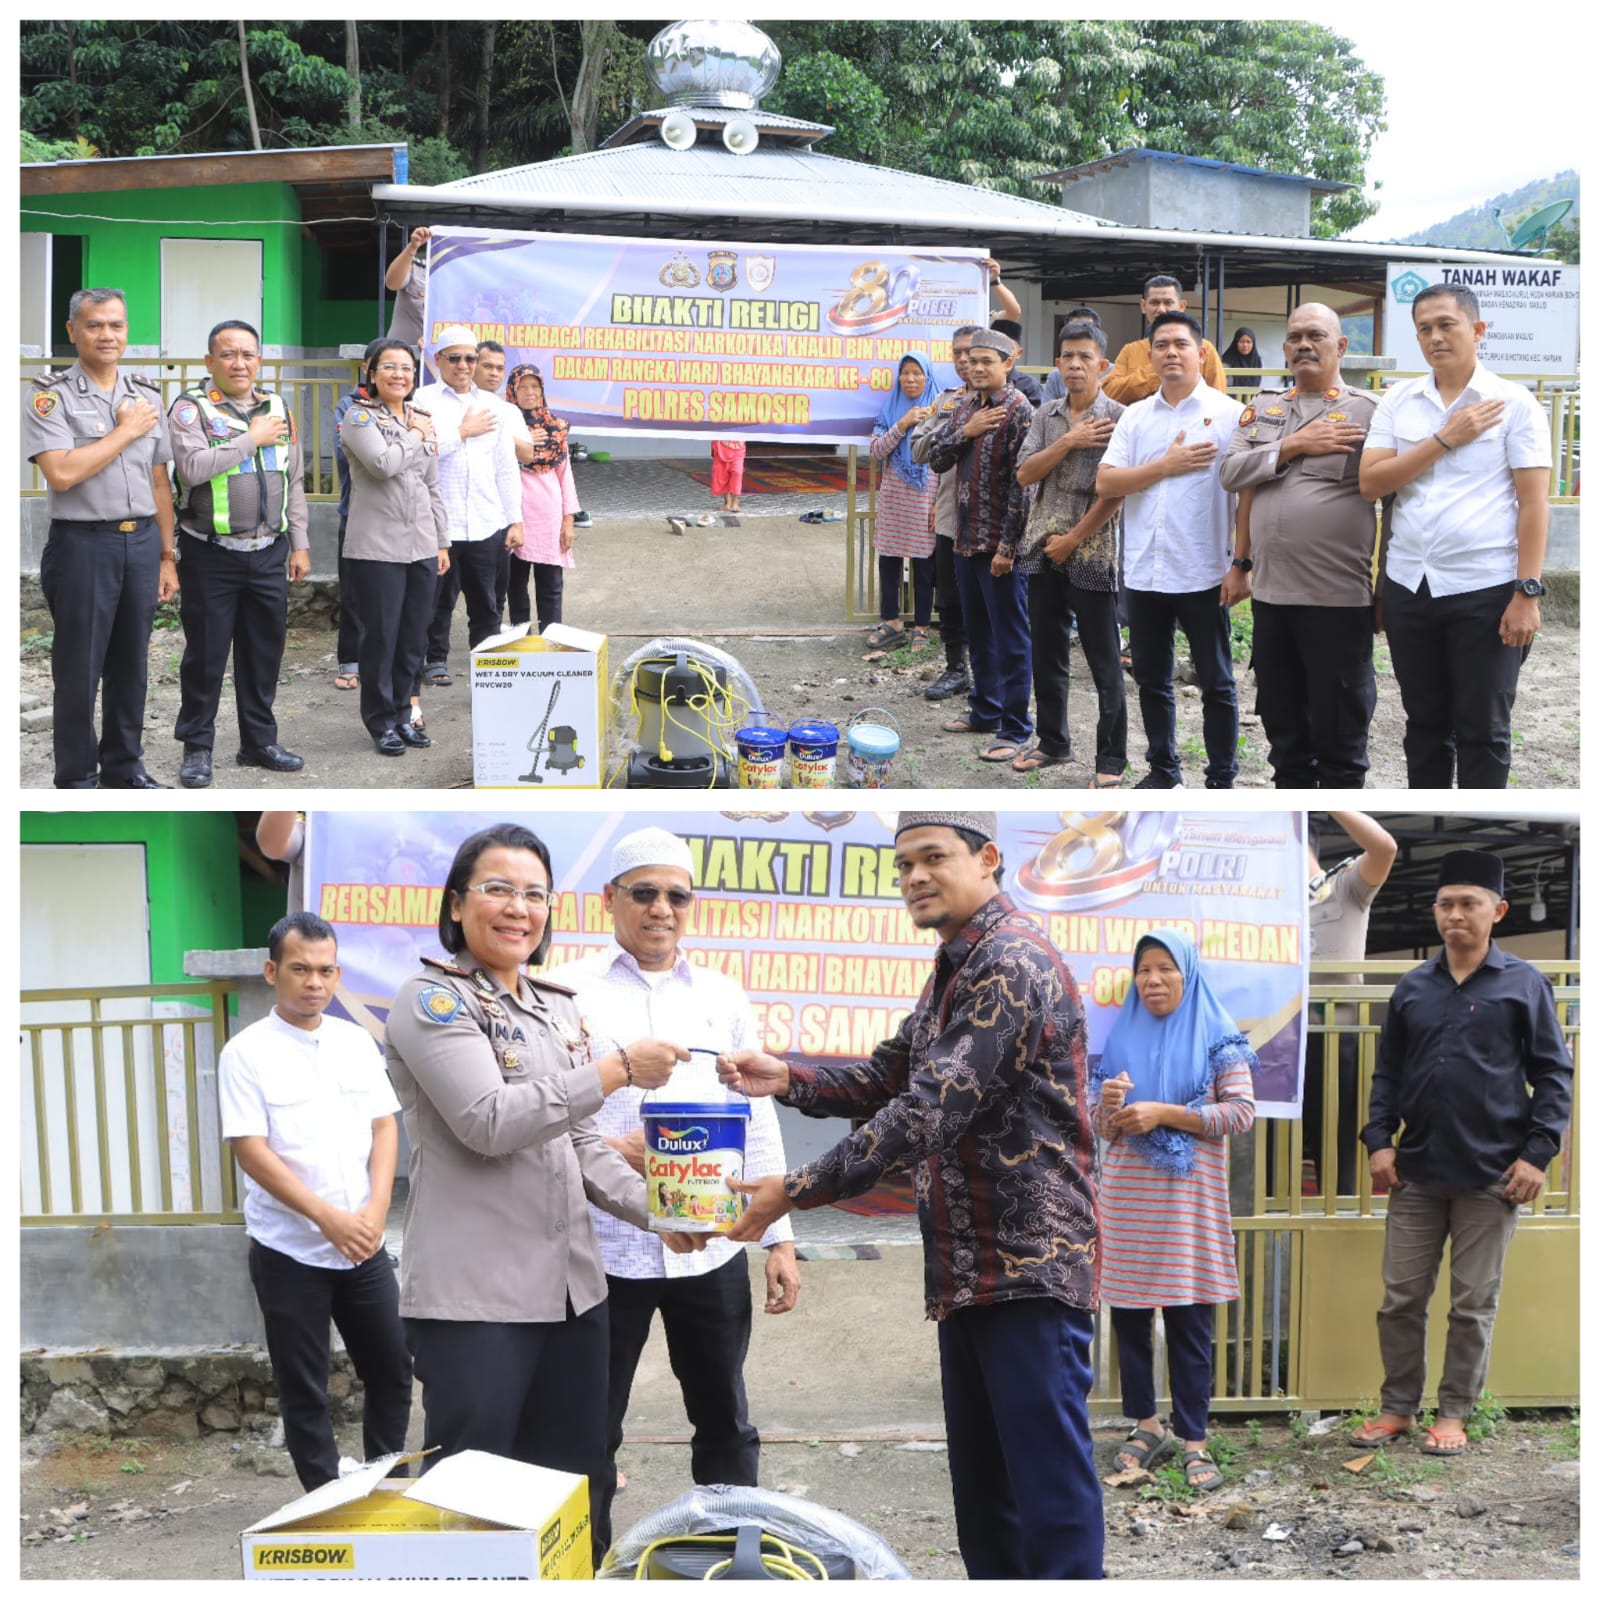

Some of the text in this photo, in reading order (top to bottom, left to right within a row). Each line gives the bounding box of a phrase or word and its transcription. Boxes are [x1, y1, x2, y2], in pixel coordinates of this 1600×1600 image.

[1442, 268, 1562, 287] TANAH WAKAF
[611, 293, 820, 332] BHAKTI RELIGI
[508, 323, 582, 349] LEMBAGA
[583, 326, 690, 353] REHABILITASI
[692, 331, 784, 358] NARKOTIKA
[786, 334, 844, 360] KHALID
[845, 336, 874, 360] BIN
[553, 355, 609, 381] DALAM
[611, 357, 677, 383] RANGKA
[678, 359, 719, 385] HARI
[721, 361, 837, 390] BHAYANGKARA
[838, 366, 859, 391] KE
[869, 366, 894, 392] 80
[623, 387, 810, 425] POLRES SAMOSIR
[476, 658, 517, 666] KRISBOW
[675, 834, 832, 897] AKTI
[1157, 850, 1248, 881] POLRI
[1049, 912, 1099, 954] BIN
[1201, 918, 1301, 965] MEDAN
[749, 950, 820, 994] HARI
[823, 955, 936, 998] BHAYAN
[1092, 965, 1134, 1009] 80
[658, 1137, 701, 1151] Dulux
[649, 1156, 722, 1184] Catylac
[258, 1548, 347, 1565] KRISBOW
